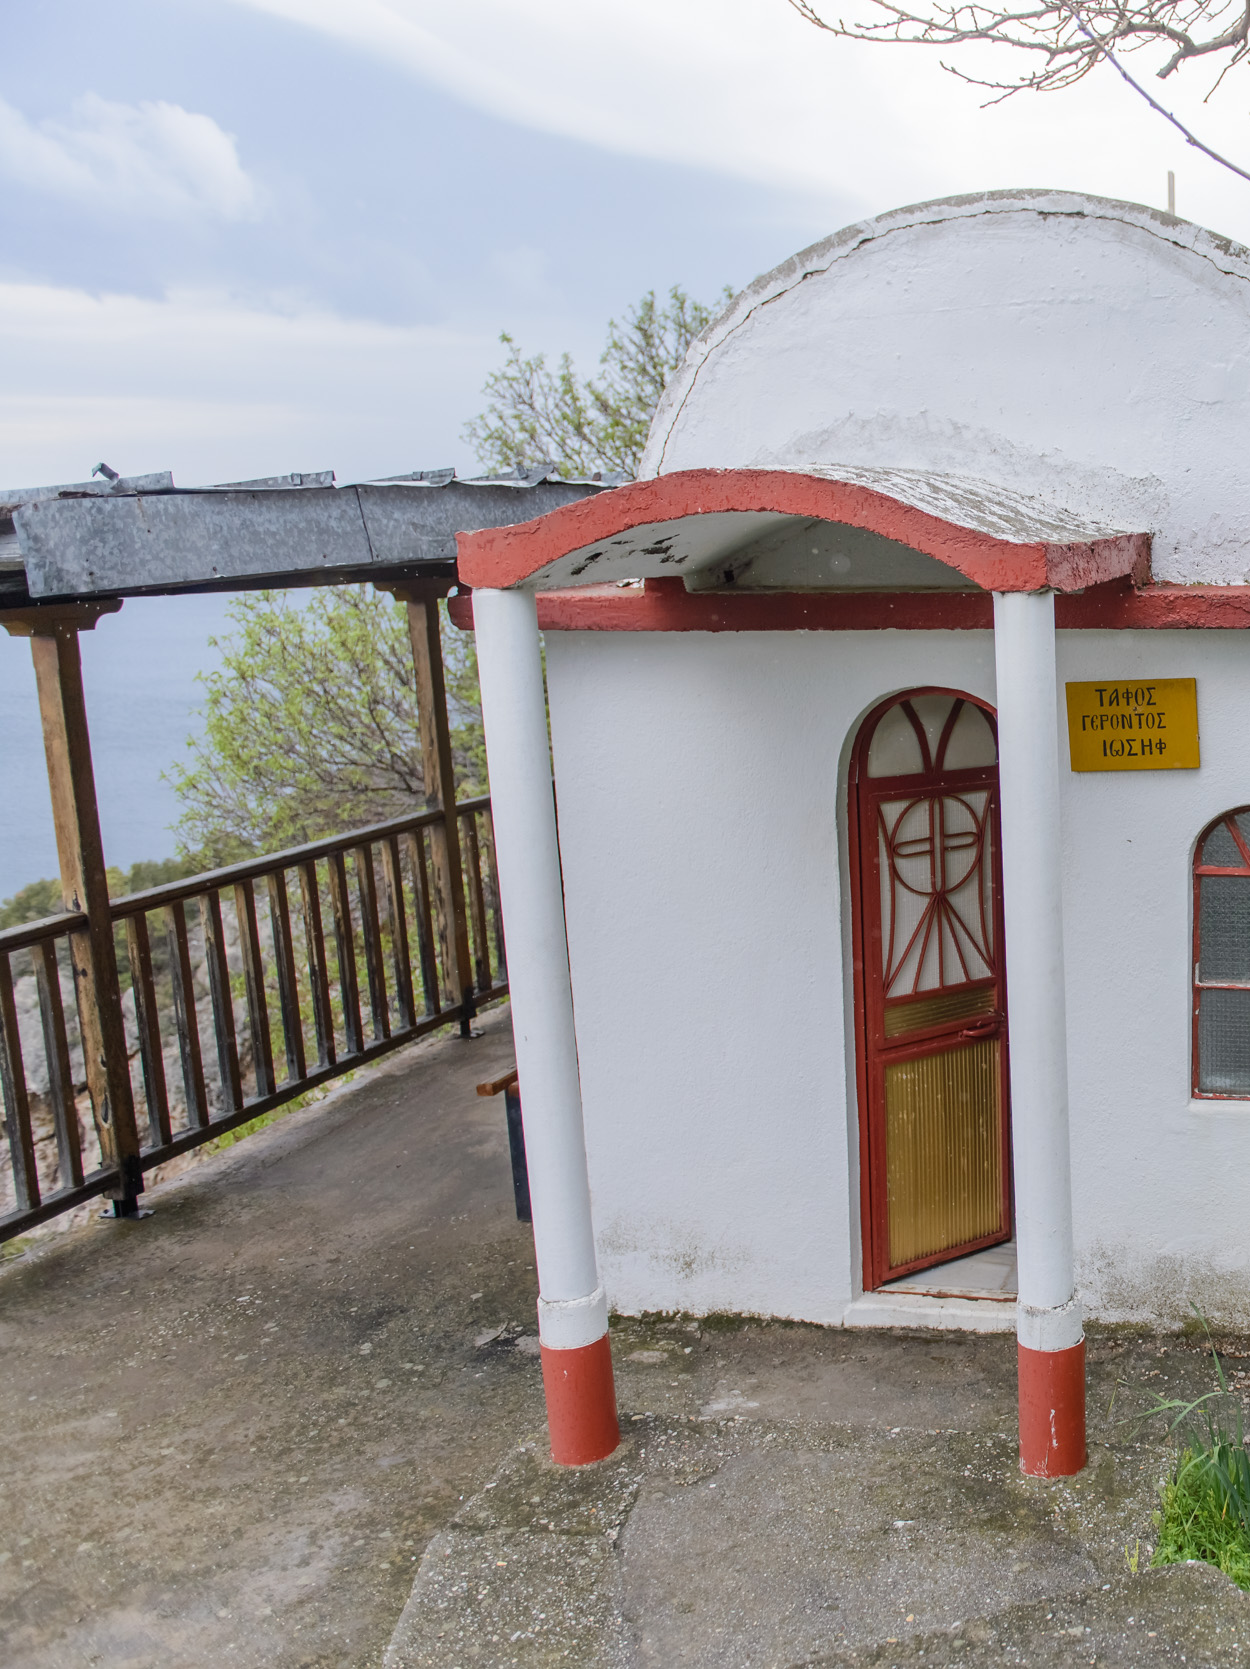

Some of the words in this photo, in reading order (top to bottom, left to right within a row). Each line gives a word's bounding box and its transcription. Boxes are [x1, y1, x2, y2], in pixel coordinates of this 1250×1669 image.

[1095, 687, 1157, 707] ΤΑΦΟΣ
[1082, 712, 1167, 731] ΓΕΡΟΝΤΟΣ
[1102, 738, 1167, 757] ΙΩΣΗΦ
